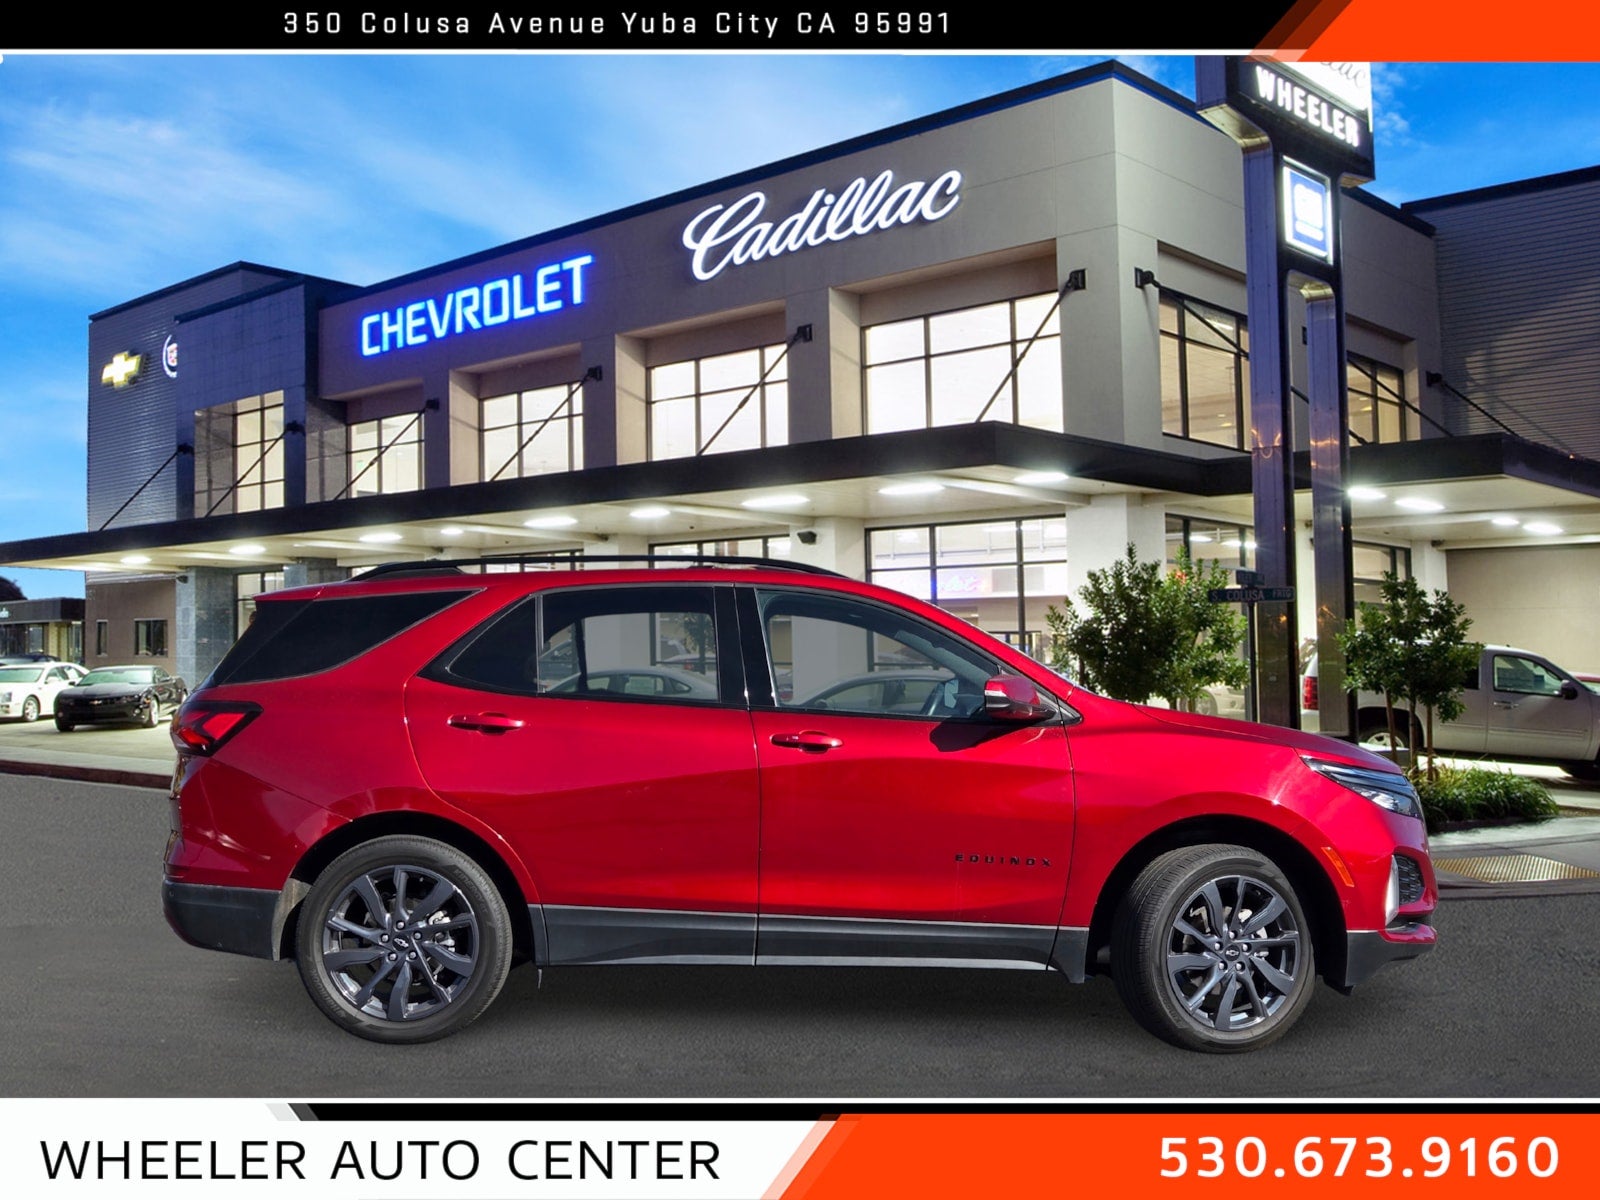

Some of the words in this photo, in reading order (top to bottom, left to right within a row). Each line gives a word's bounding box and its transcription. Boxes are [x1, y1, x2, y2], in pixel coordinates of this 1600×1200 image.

[1255, 66, 1360, 147] WHEELER
[682, 168, 964, 281] Cadillac
[360, 254, 594, 357] CHEVROLET
[1226, 589, 1265, 601] COLUSA
[955, 853, 1051, 867] EQUINOX
